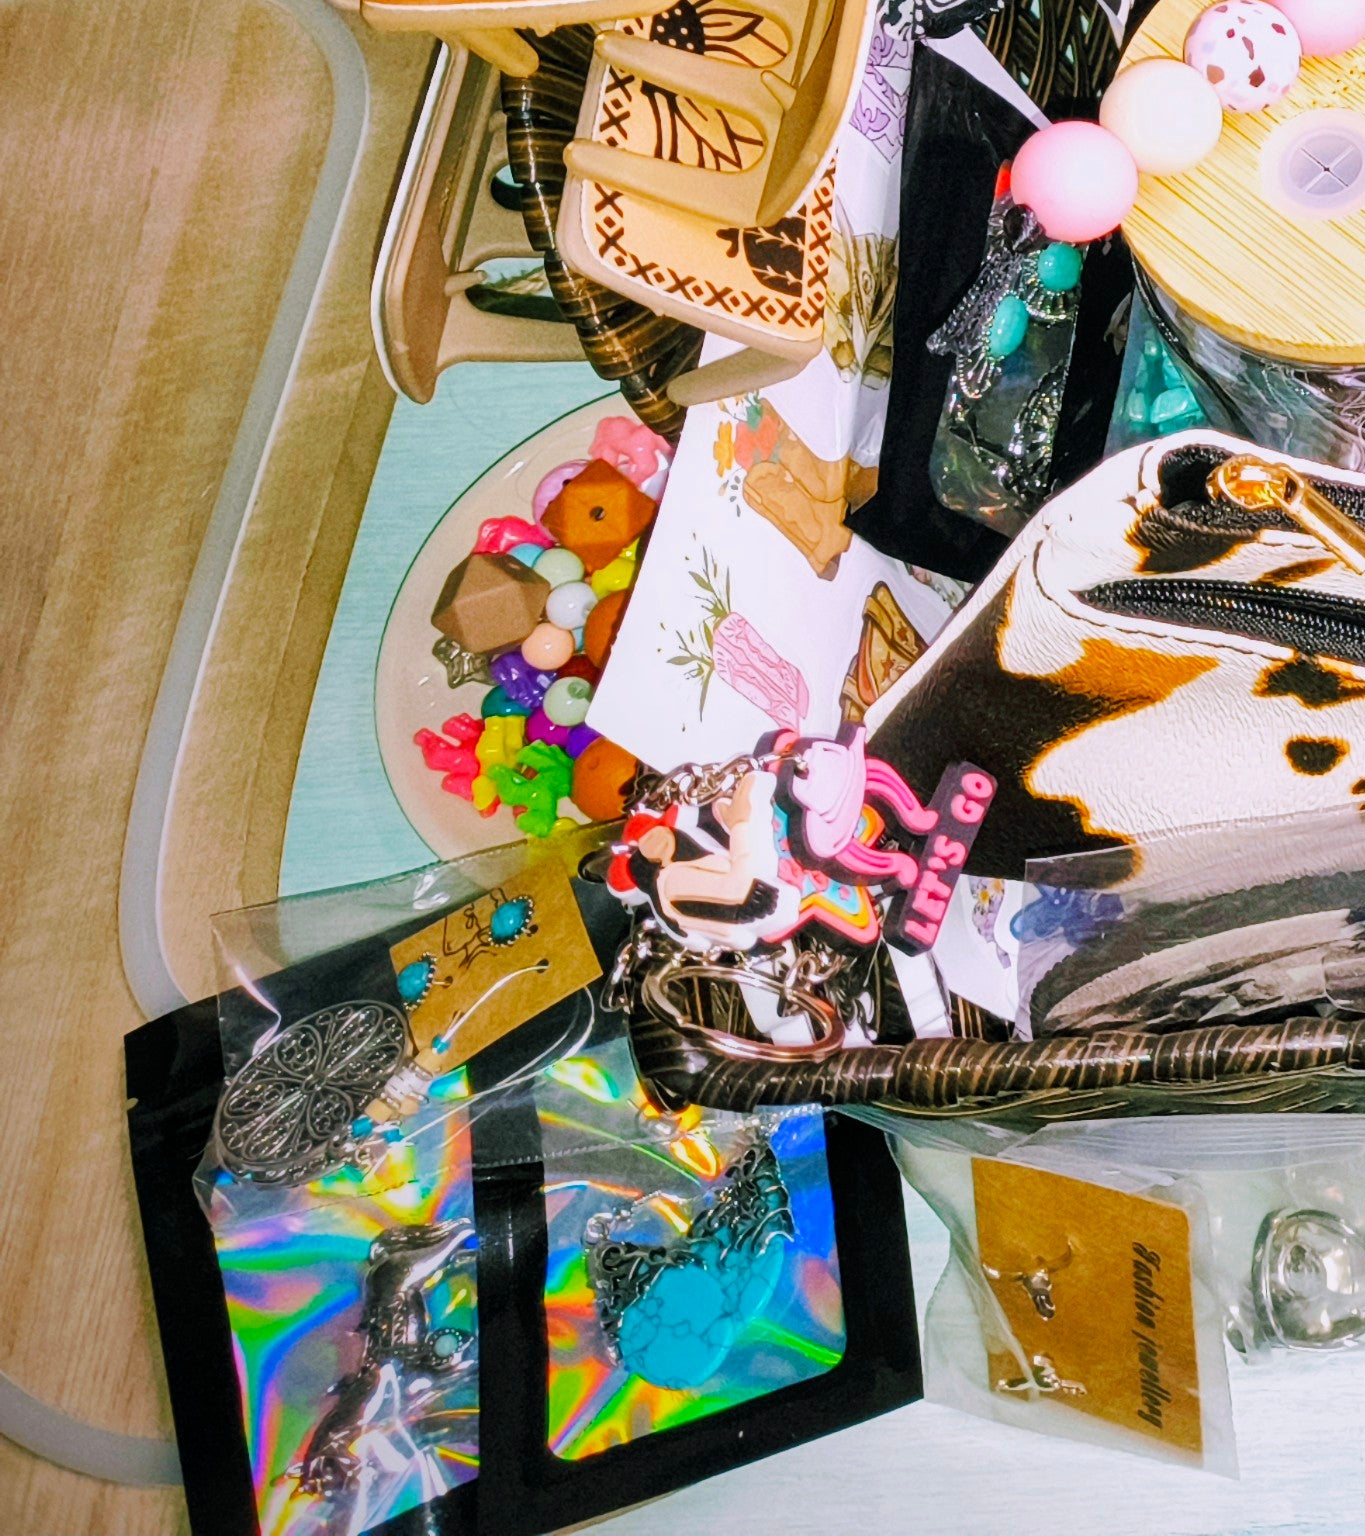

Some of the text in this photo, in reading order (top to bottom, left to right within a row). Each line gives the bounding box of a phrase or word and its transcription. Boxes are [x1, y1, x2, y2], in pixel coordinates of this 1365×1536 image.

[904, 772, 994, 946] LET'S GO
[1132, 1241, 1164, 1329] Fashion
